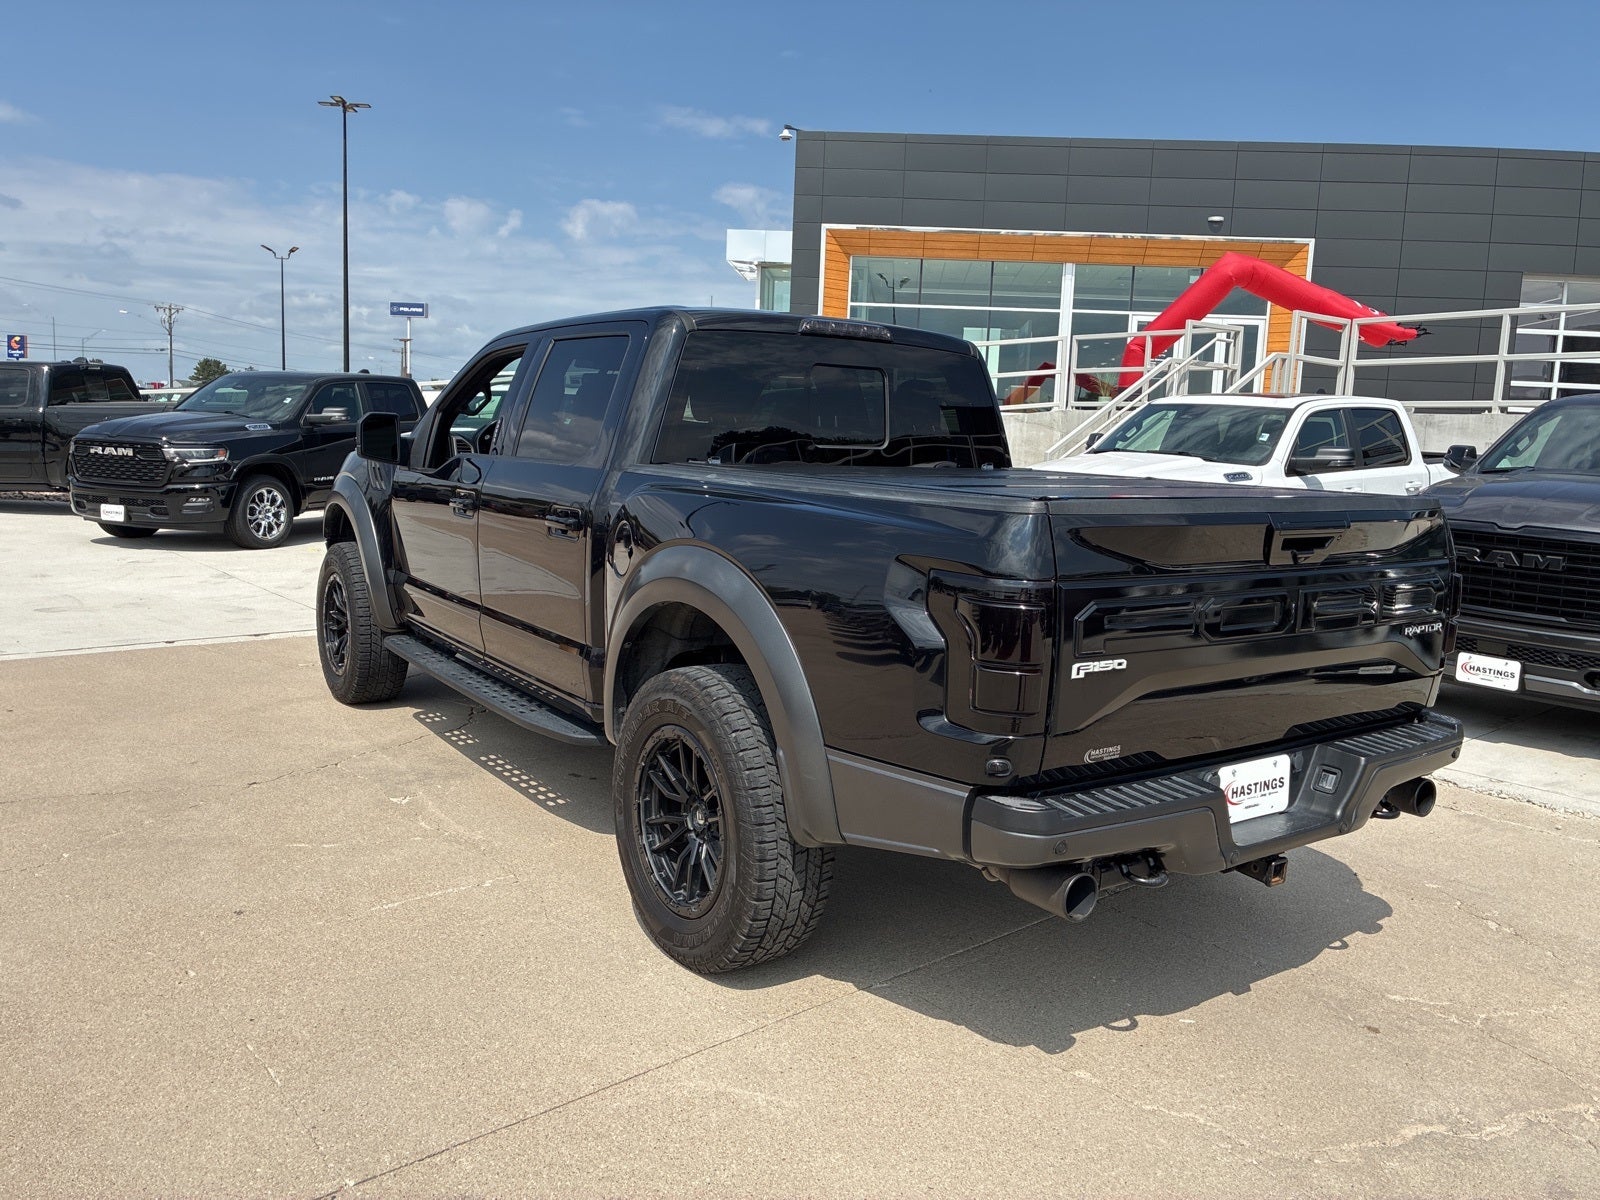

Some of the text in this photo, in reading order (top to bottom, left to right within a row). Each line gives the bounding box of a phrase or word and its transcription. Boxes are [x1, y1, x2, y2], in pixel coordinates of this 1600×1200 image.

[89, 446, 134, 457] RAM
[1454, 544, 1566, 571] RAM
[1073, 573, 1445, 657] FORD
[1404, 622, 1443, 636] RAPTOR
[1469, 664, 1516, 679] HASTINGS
[1090, 744, 1121, 756] HASTINGS
[1230, 776, 1285, 800] HASTINGS
